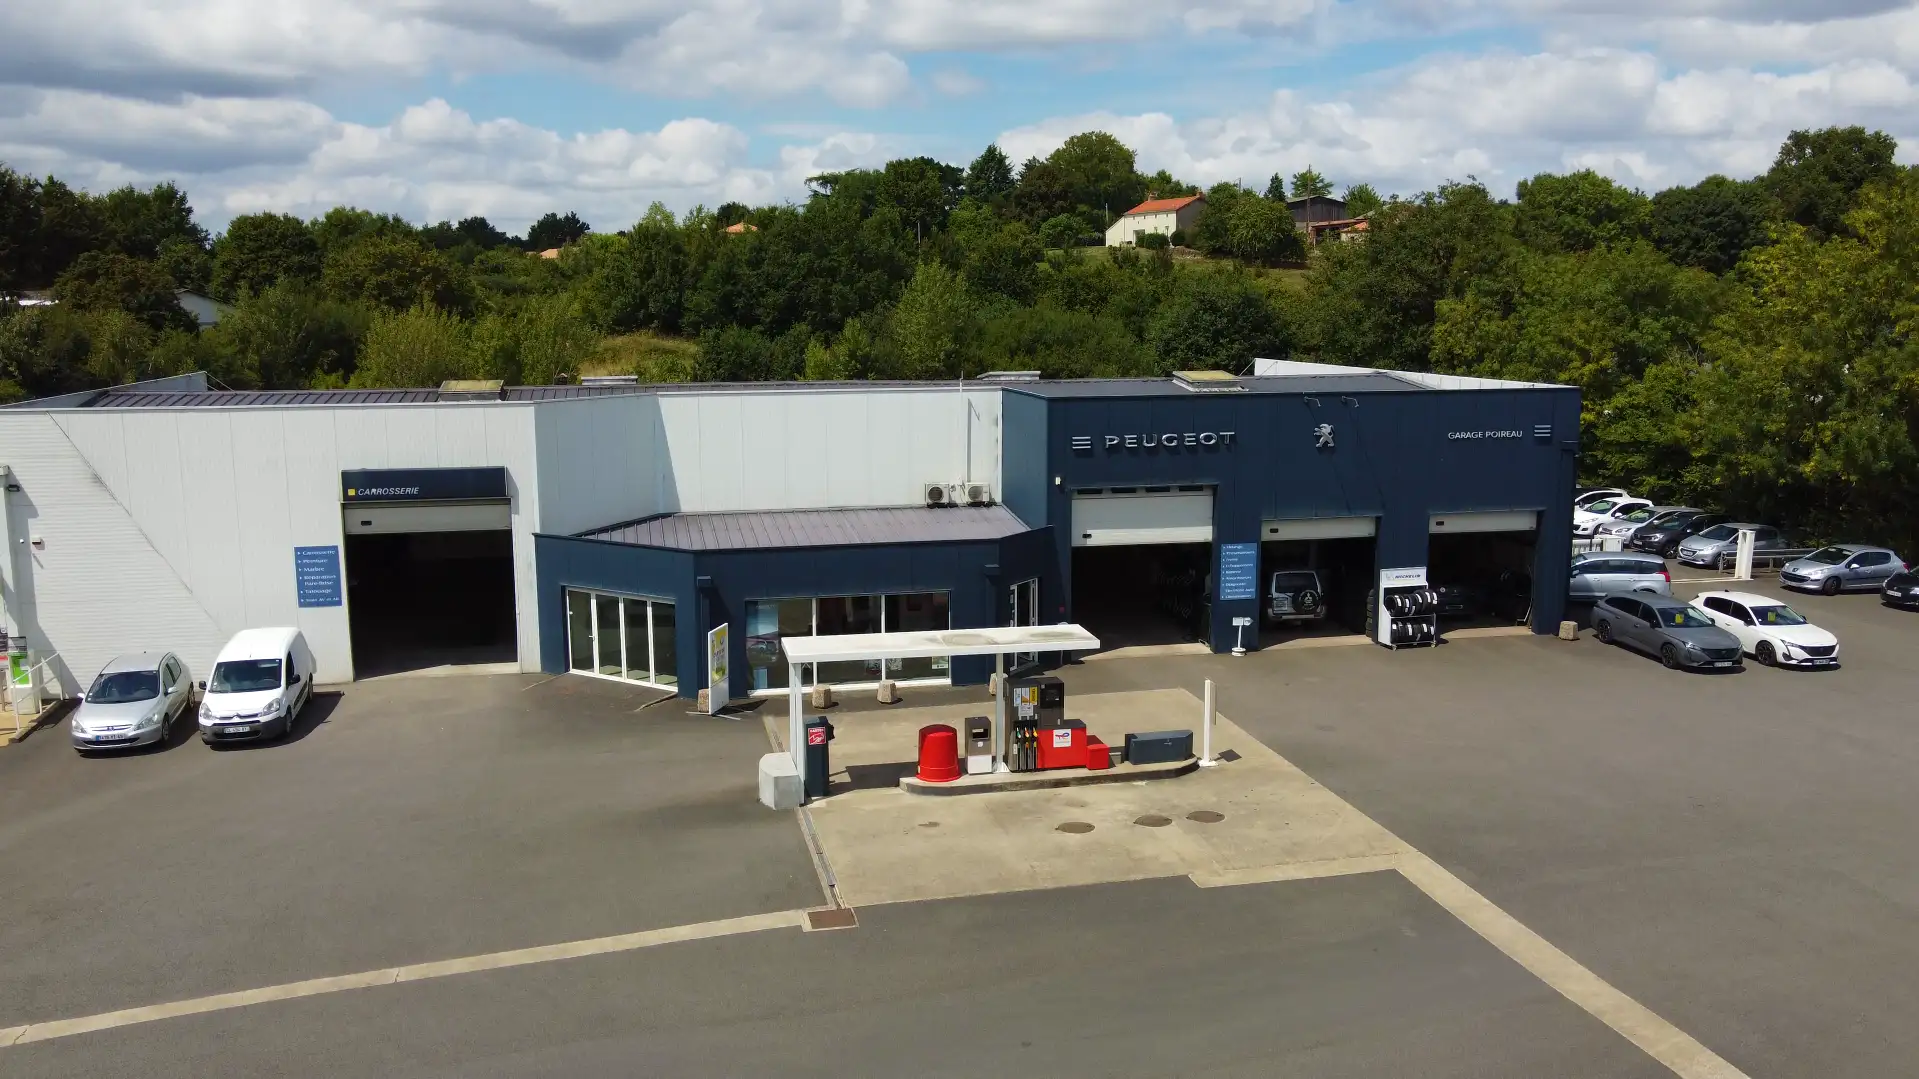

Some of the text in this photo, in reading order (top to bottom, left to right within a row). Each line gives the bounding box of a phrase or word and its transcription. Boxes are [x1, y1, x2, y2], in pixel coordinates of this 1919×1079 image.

[1485, 430, 1523, 438] POIREAU
[1104, 432, 1235, 449] PEUGEOT
[358, 487, 420, 496] CARROSSERIE
